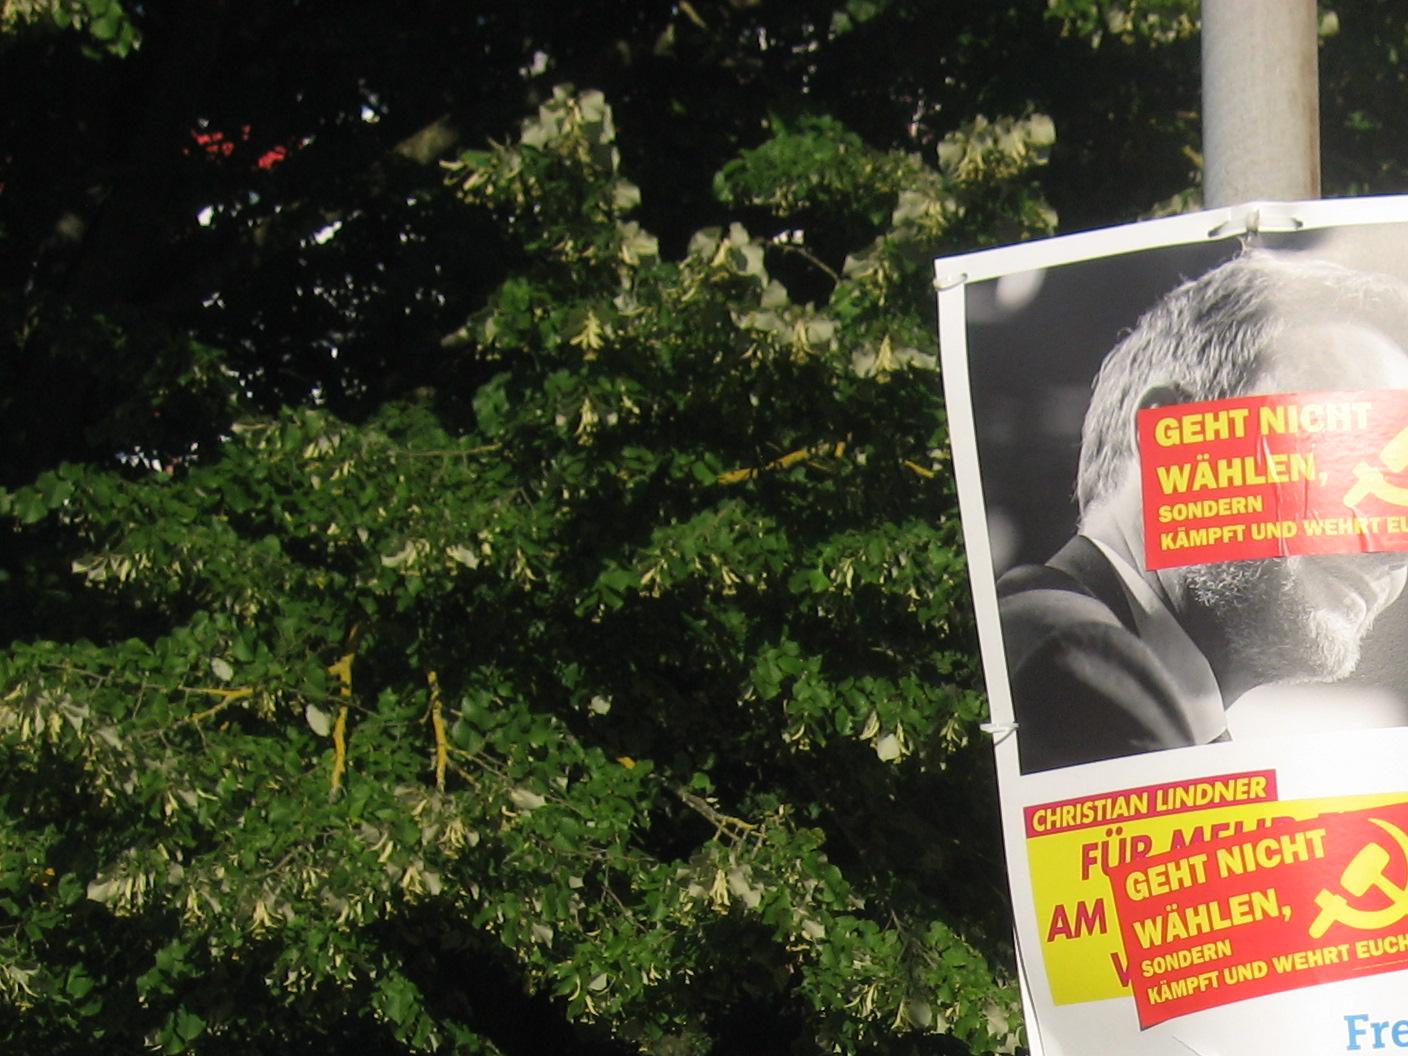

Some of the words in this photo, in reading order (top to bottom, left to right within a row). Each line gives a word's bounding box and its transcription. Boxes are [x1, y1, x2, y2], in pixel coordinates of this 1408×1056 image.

[1155, 408, 1250, 447] GEHT
[1260, 402, 1372, 435] NICHT
[1156, 452, 1328, 496] WÄHLEN,
[1158, 495, 1263, 523] SONDERN
[1160, 524, 1246, 551] KÄMPFT
[1251, 520, 1297, 541] UND
[1305, 516, 1381, 536] WEHRT
[1032, 791, 1149, 833] CHRISTIAN
[1156, 775, 1268, 812] LINDNER
[1125, 854, 1208, 902] GEHT
[1216, 828, 1327, 879] NICHT
[1046, 897, 1108, 943] AM
[1132, 888, 1292, 949] WÄHLEN,
[1141, 939, 1232, 978] SONDERN
[1147, 969, 1220, 1005] KÄMPFT
[1224, 960, 1268, 986] UND
[1272, 942, 1350, 976] WEHRT
